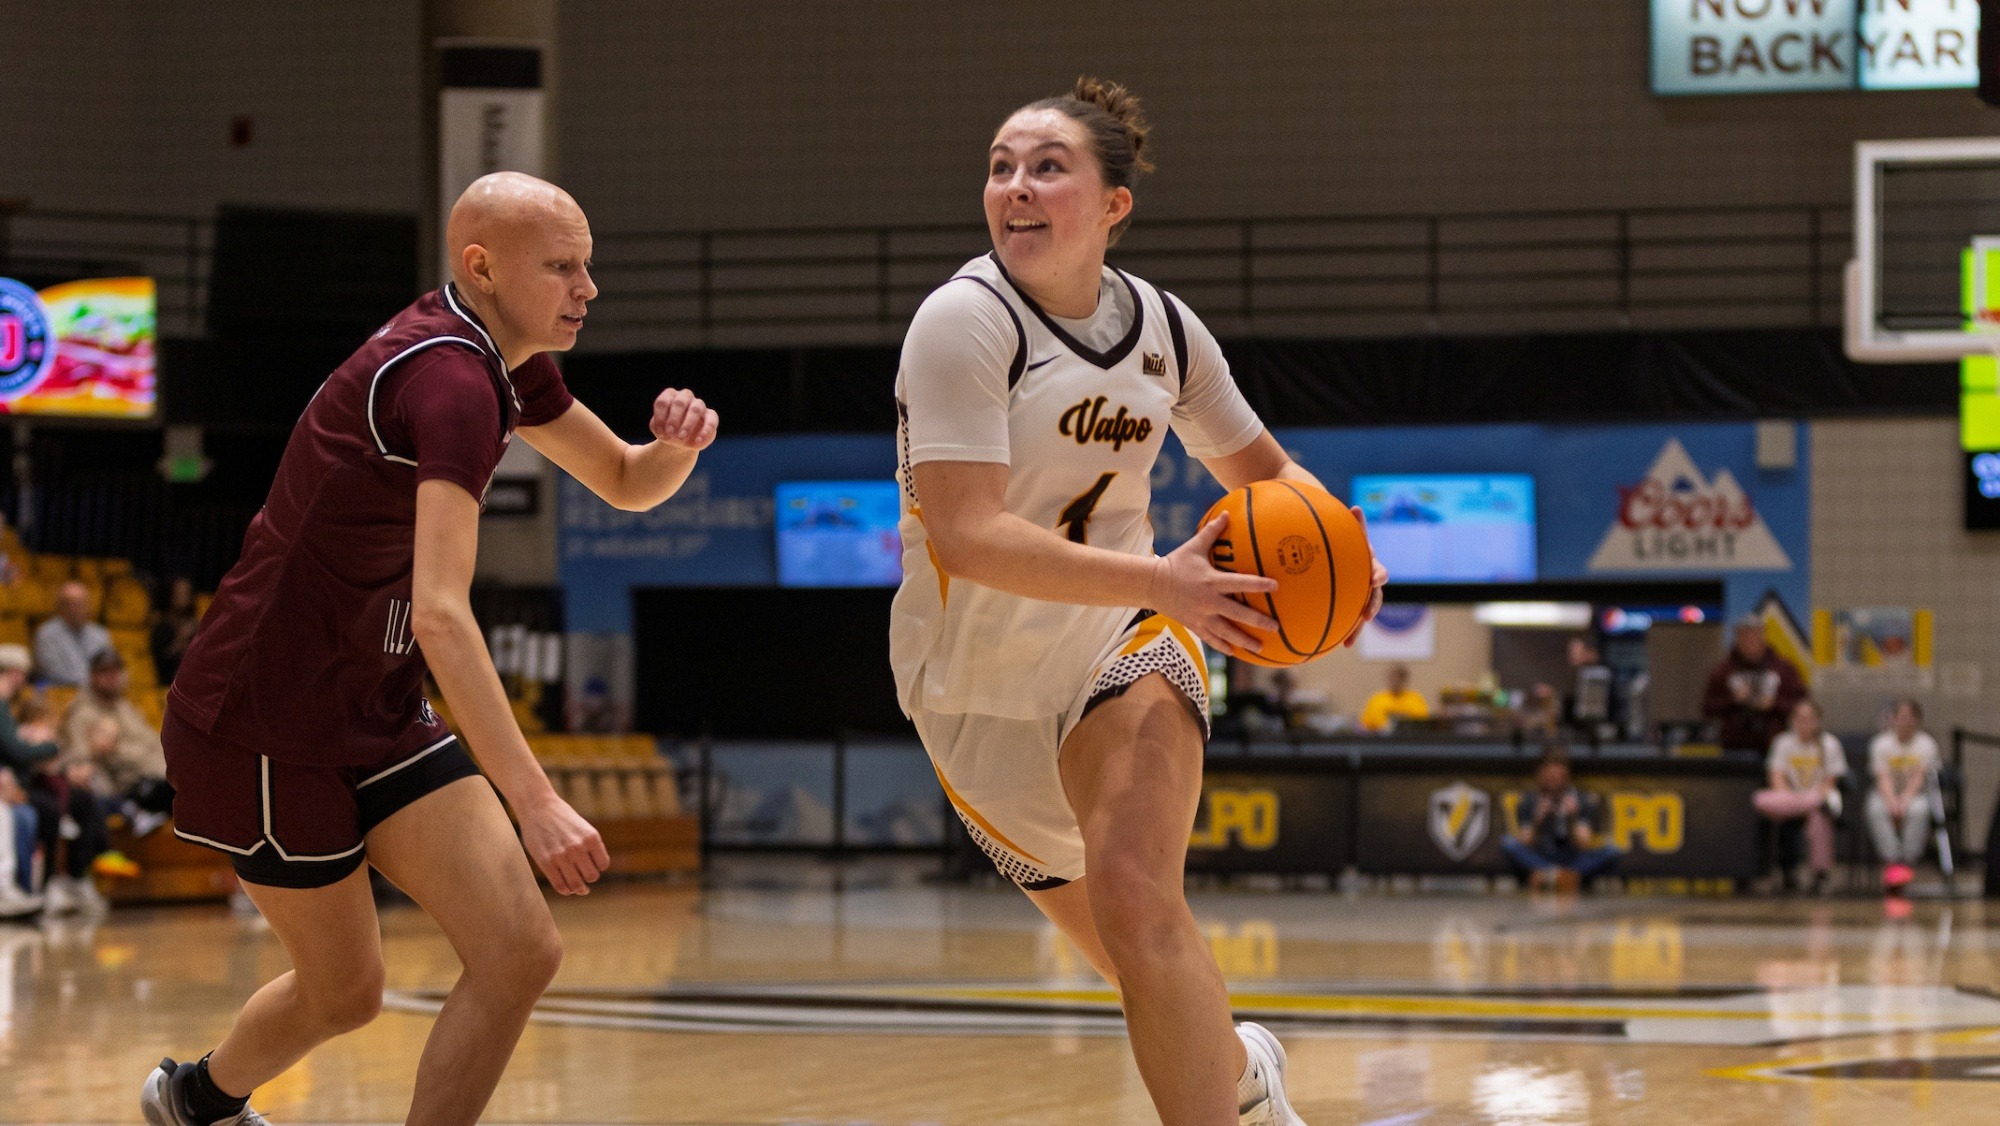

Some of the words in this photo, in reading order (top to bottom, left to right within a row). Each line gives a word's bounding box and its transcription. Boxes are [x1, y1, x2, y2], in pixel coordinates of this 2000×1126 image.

[1689, 29, 1981, 75] BACKYAR
[1058, 394, 1153, 452] Valpo
[1615, 477, 1756, 531] Coors
[1633, 532, 1736, 560] LIGHT
